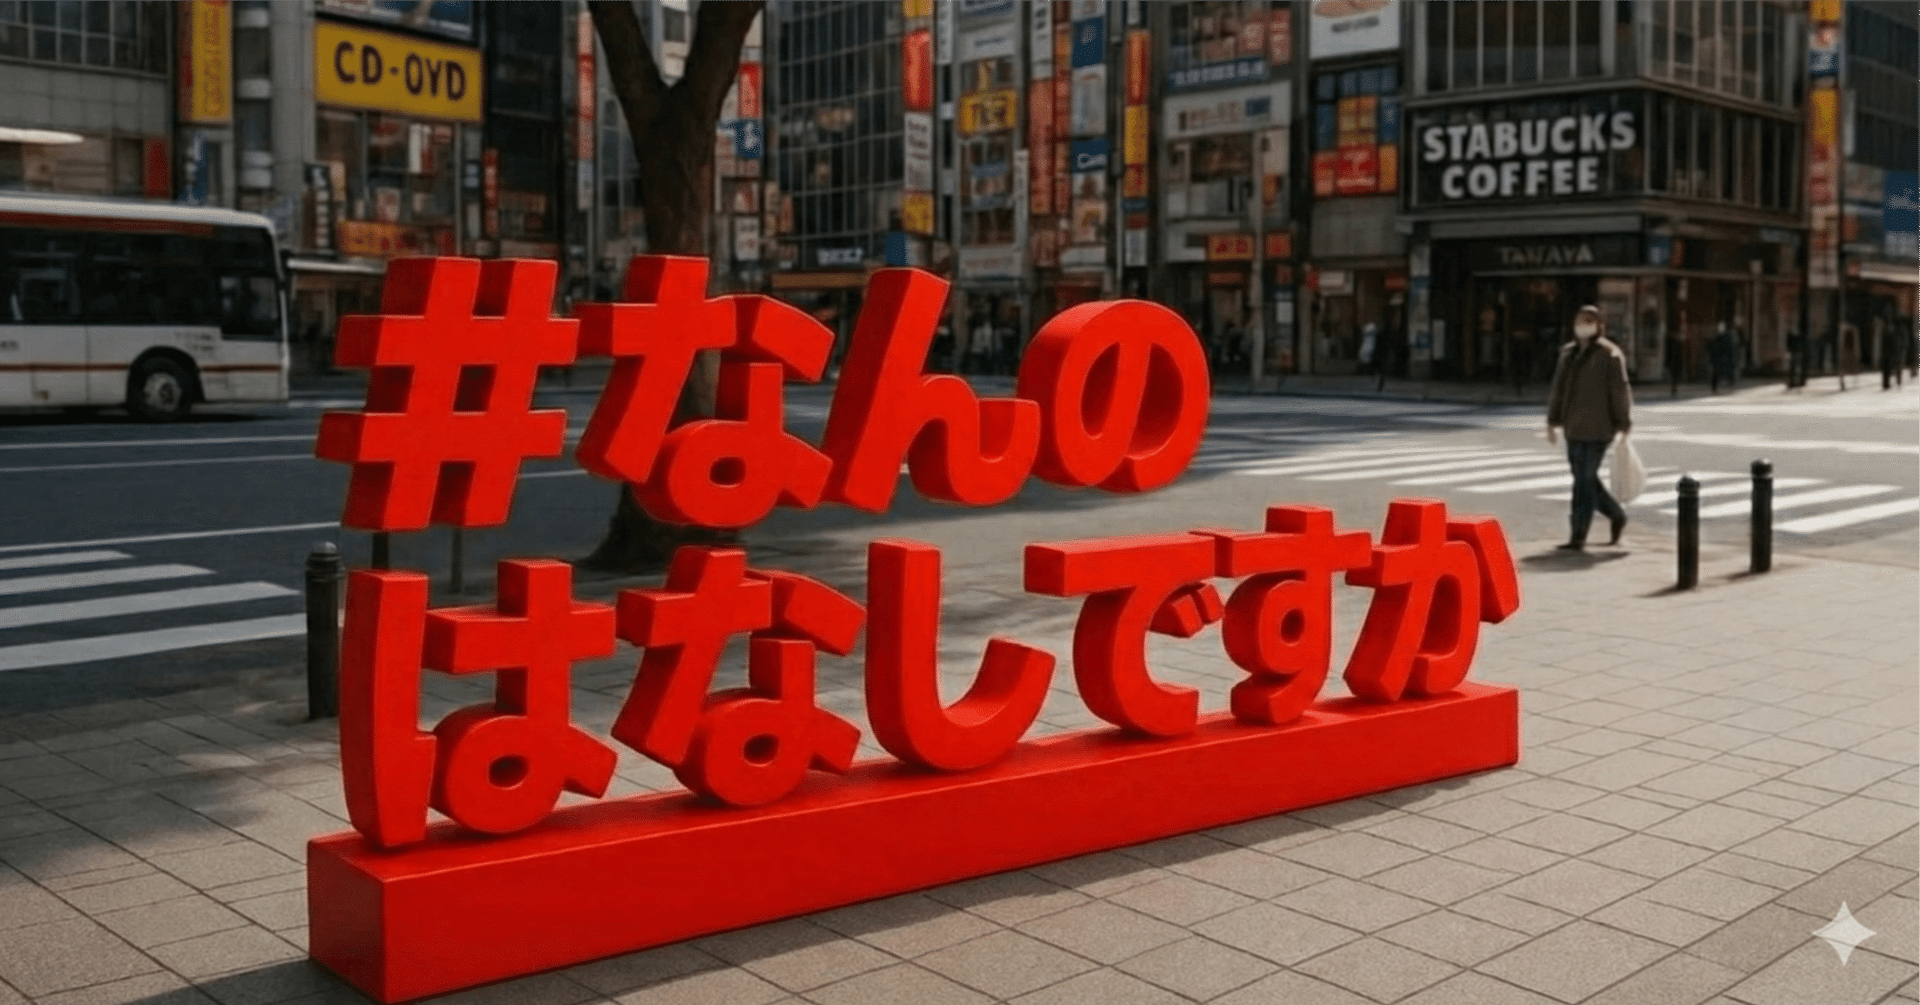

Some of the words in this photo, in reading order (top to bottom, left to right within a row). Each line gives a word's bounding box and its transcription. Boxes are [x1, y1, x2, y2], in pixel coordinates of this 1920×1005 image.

[1422, 111, 1636, 162] STABUCKS
[1441, 157, 1599, 199] COFFEE
[317, 255, 1211, 529] #なんの
[341, 500, 1520, 848] はなしですか
